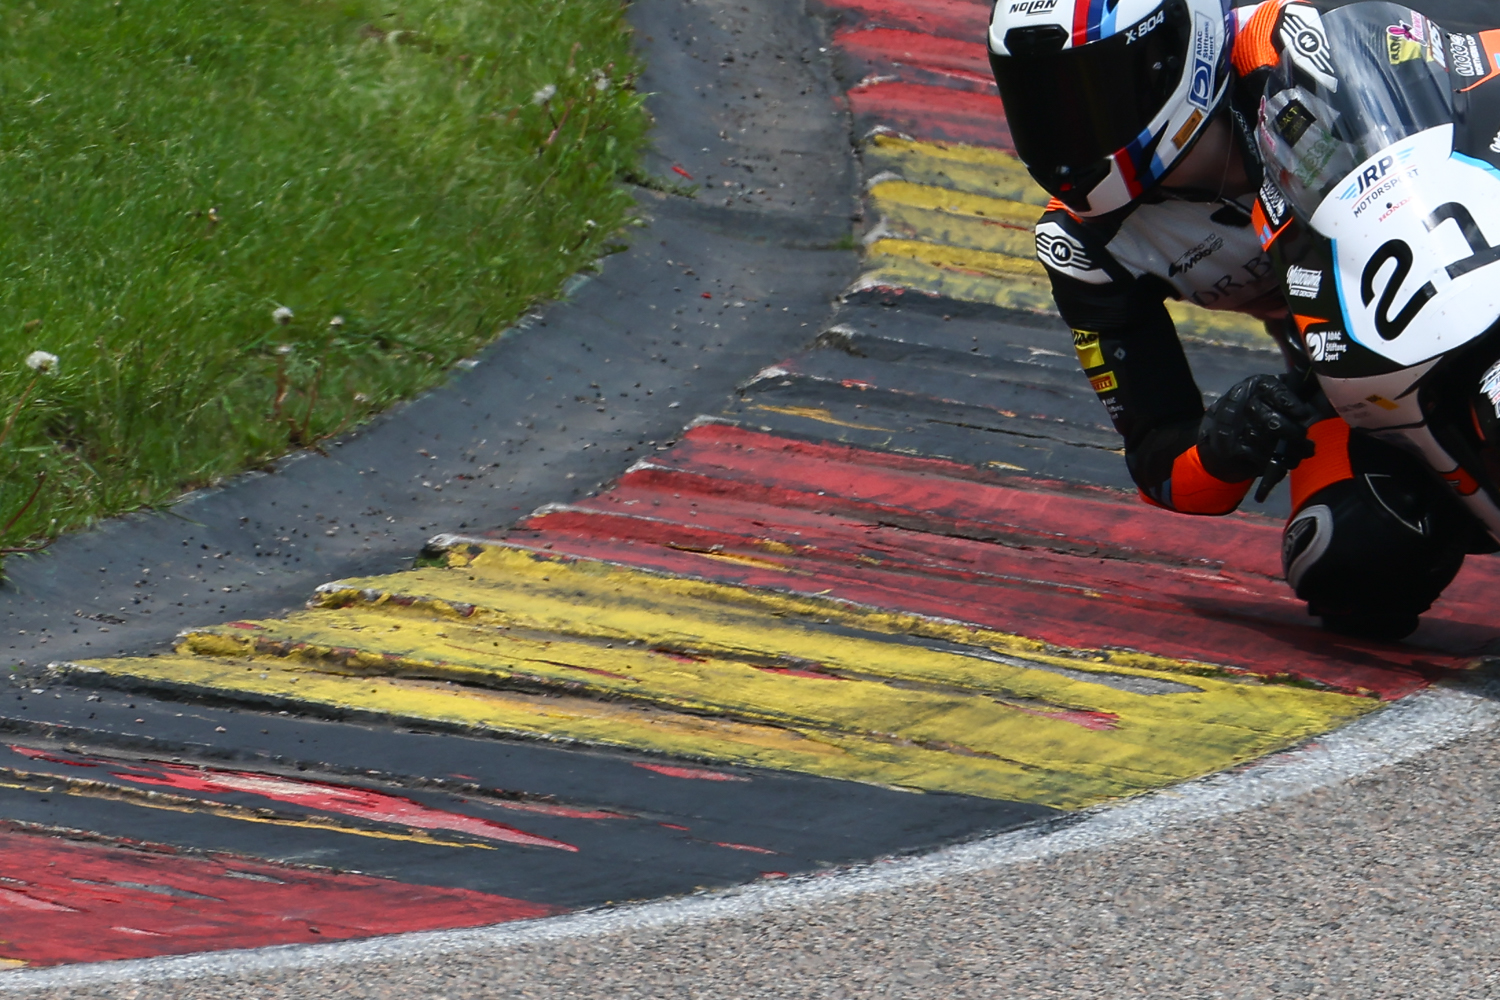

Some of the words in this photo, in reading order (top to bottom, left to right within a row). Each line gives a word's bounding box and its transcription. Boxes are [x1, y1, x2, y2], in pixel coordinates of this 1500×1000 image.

[1009, 0, 1058, 15] NOLAN
[1125, 10, 1165, 45] X-804
[1195, 30, 1204, 56] ADAC
[1465, 34, 1477, 46] CUP
[1357, 155, 1394, 194] JRP
[1353, 168, 1420, 218] MOTORSPRT
[1073, 330, 1099, 346] DAC
[1326, 331, 1342, 341] ADAC
[1325, 342, 1347, 353] Stiftung
[1324, 352, 1339, 362] Sport
